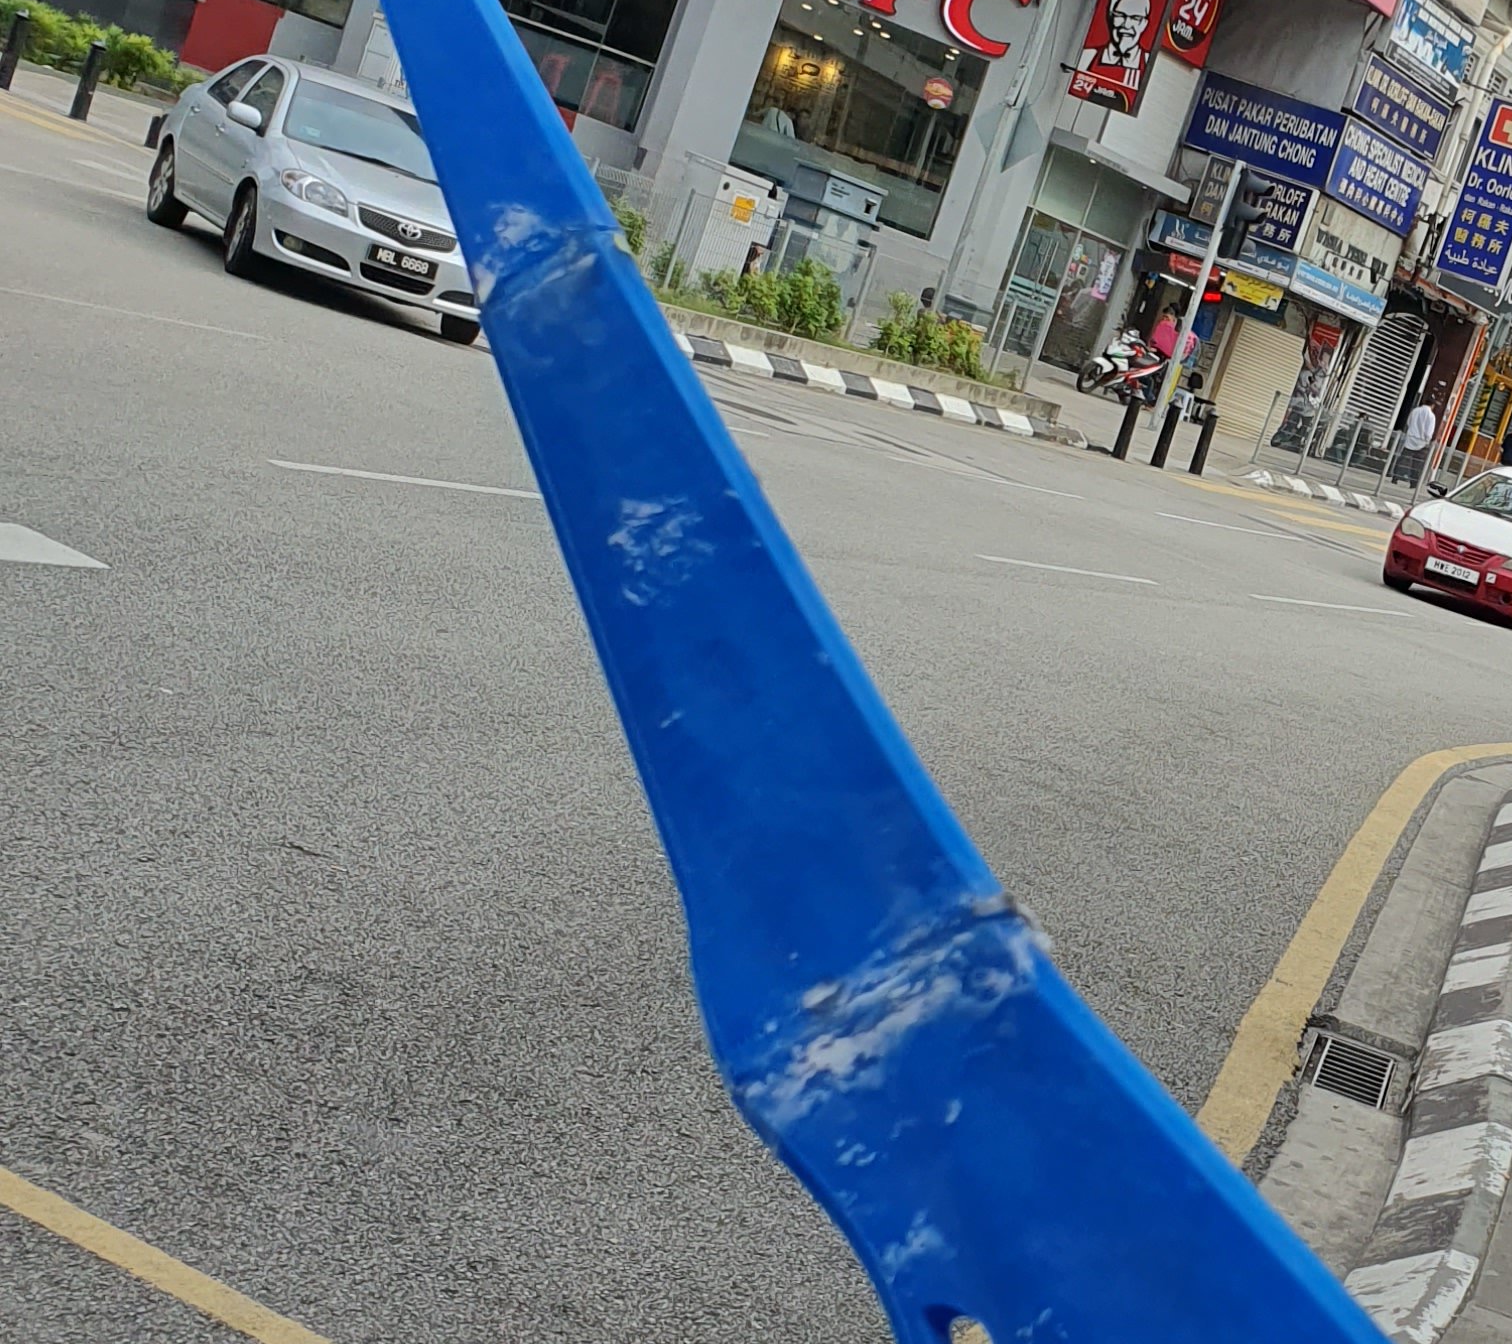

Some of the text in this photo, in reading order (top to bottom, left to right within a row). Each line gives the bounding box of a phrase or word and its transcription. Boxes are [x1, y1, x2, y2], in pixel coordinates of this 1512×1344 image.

[1072, 78, 1094, 95] 24
[1202, 87, 1339, 149] PUSAT PAKAR PERUBATAN
[1204, 114, 1318, 169] DAN JANTUNG CHONG
[1344, 124, 1371, 157] CHONG
[1347, 155, 1368, 182] AND
[1363, 163, 1390, 194] HEART
[1467, 172, 1484, 192] Dr.
[1460, 207, 1511, 236] 柯羅夫
[401, 256, 429, 275] 6668
[1444, 244, 1498, 276] عيادة طبية
[1450, 564, 1472, 580] 2012
